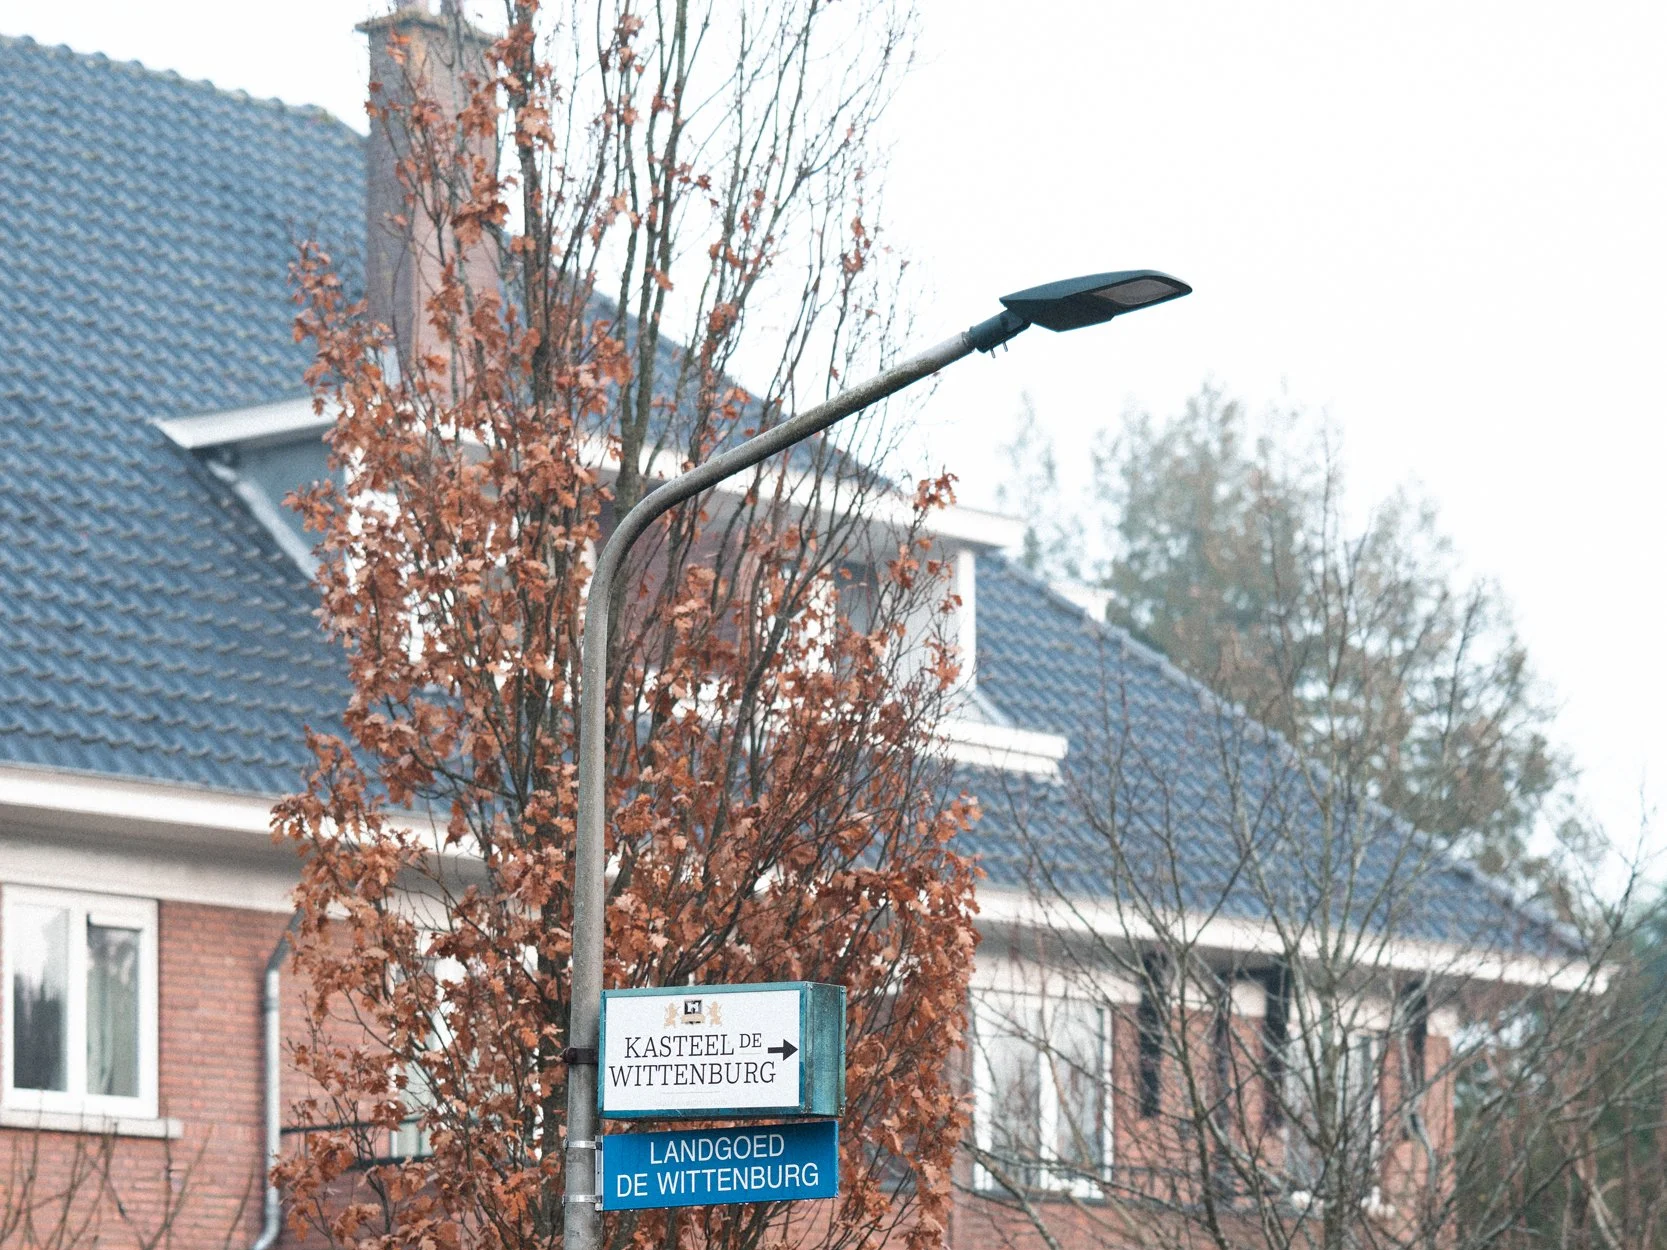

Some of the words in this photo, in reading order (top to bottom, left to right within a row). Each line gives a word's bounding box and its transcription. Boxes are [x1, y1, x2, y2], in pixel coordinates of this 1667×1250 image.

[624, 1033, 734, 1059] KASTEEL
[740, 1032, 762, 1048] DE
[608, 1061, 776, 1087] WITTENBURG
[650, 1133, 784, 1165] LANDGOED
[616, 1173, 648, 1198] DE
[657, 1162, 819, 1195] WITTENBURG
